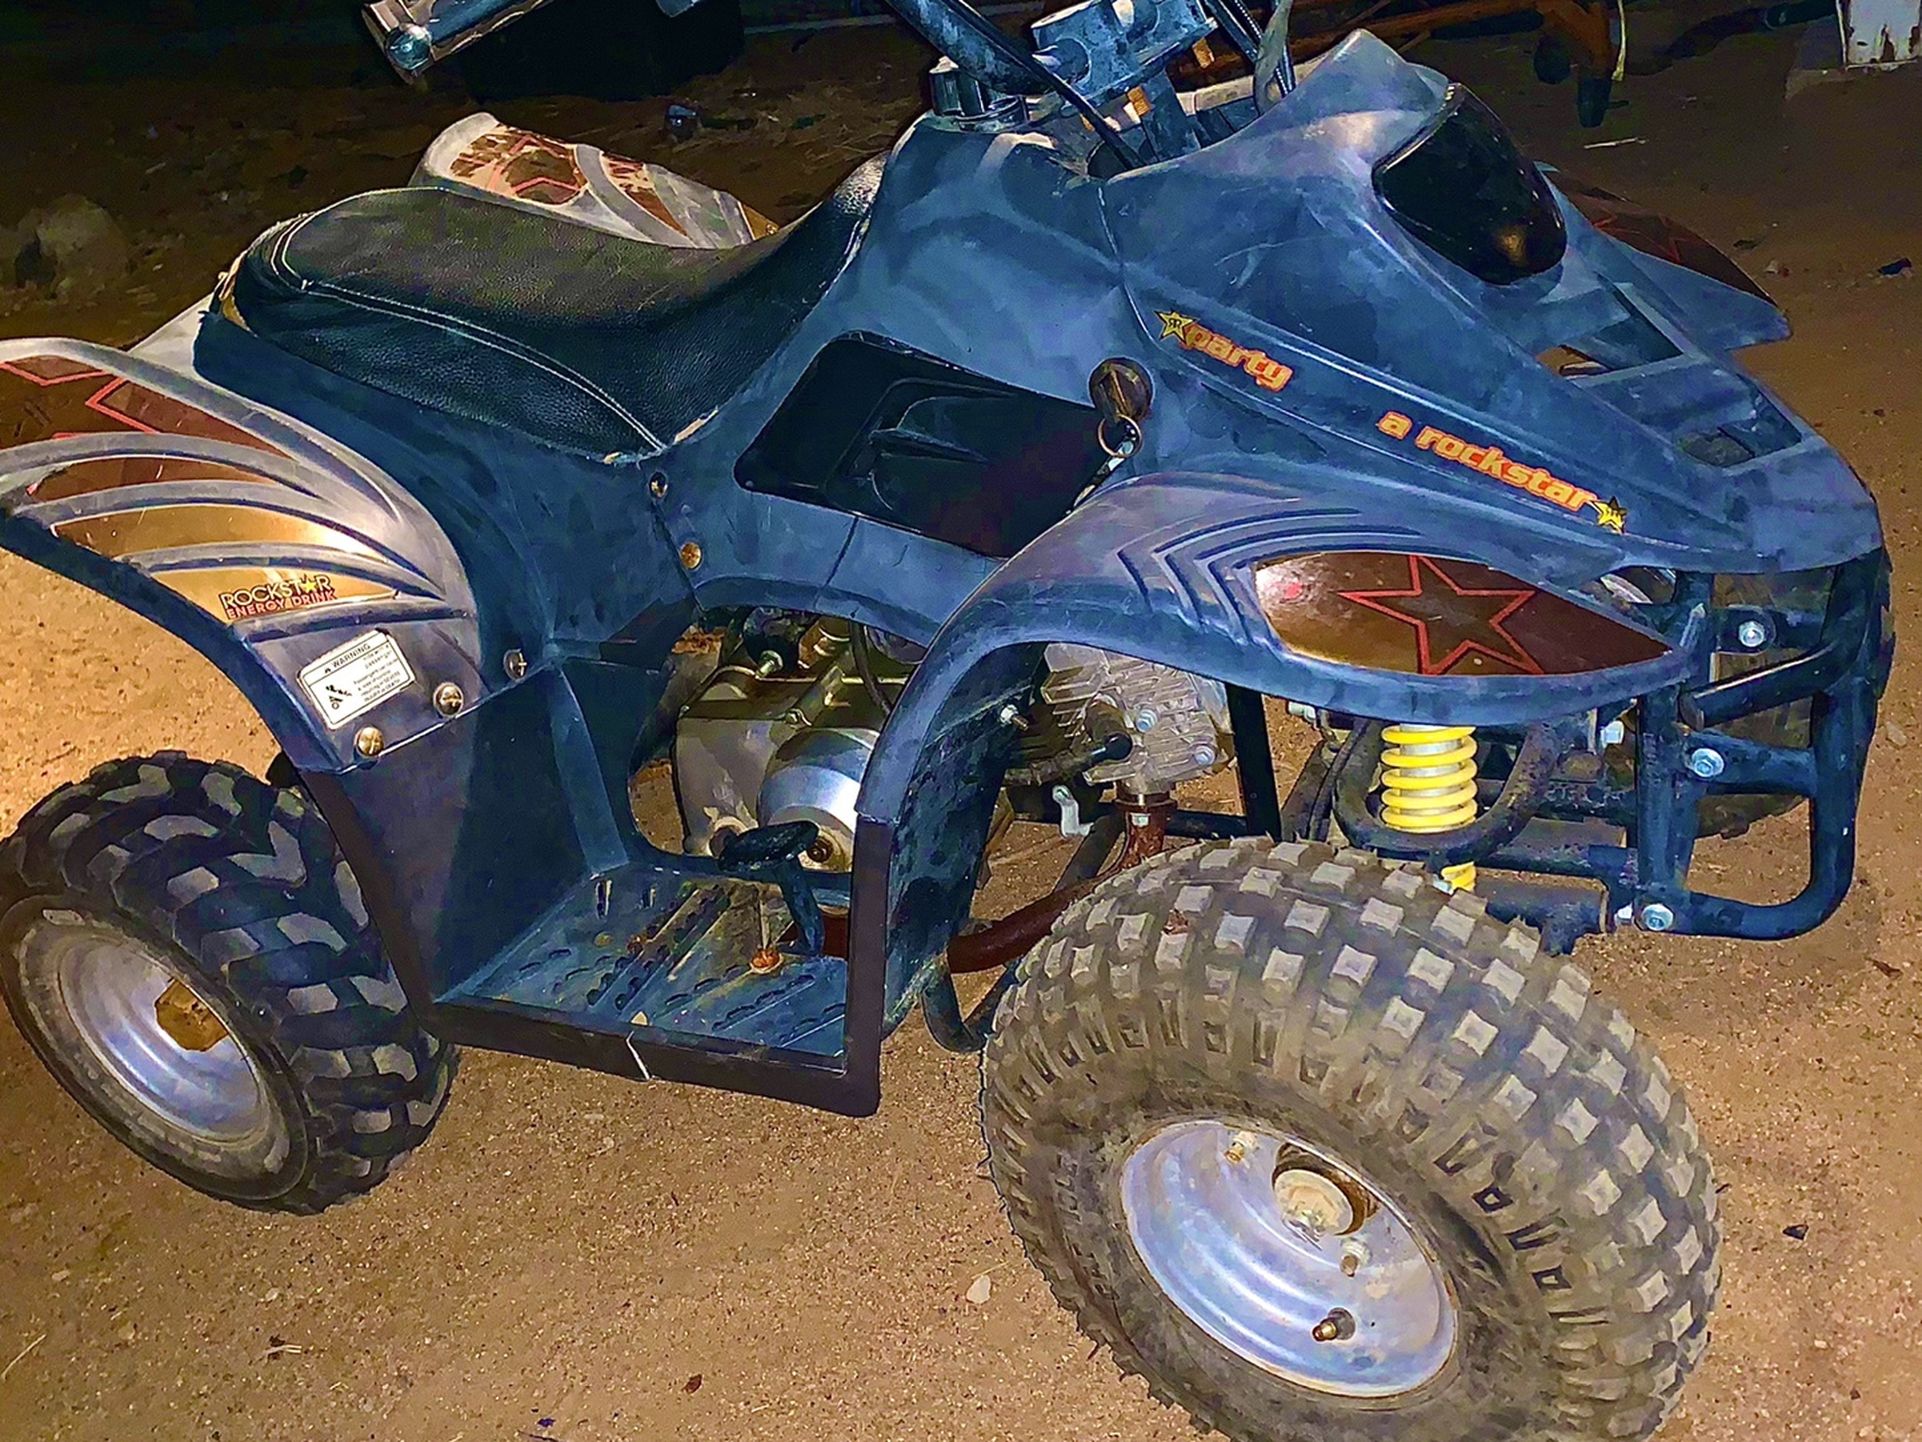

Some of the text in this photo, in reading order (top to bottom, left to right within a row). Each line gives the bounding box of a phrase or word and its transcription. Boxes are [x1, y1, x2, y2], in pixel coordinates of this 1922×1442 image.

[1182, 323, 1293, 393] party
[1377, 411, 1601, 513] a rockstar
[225, 589, 338, 620] ENERGY DRINK
[332, 643, 371, 668] WARNING
